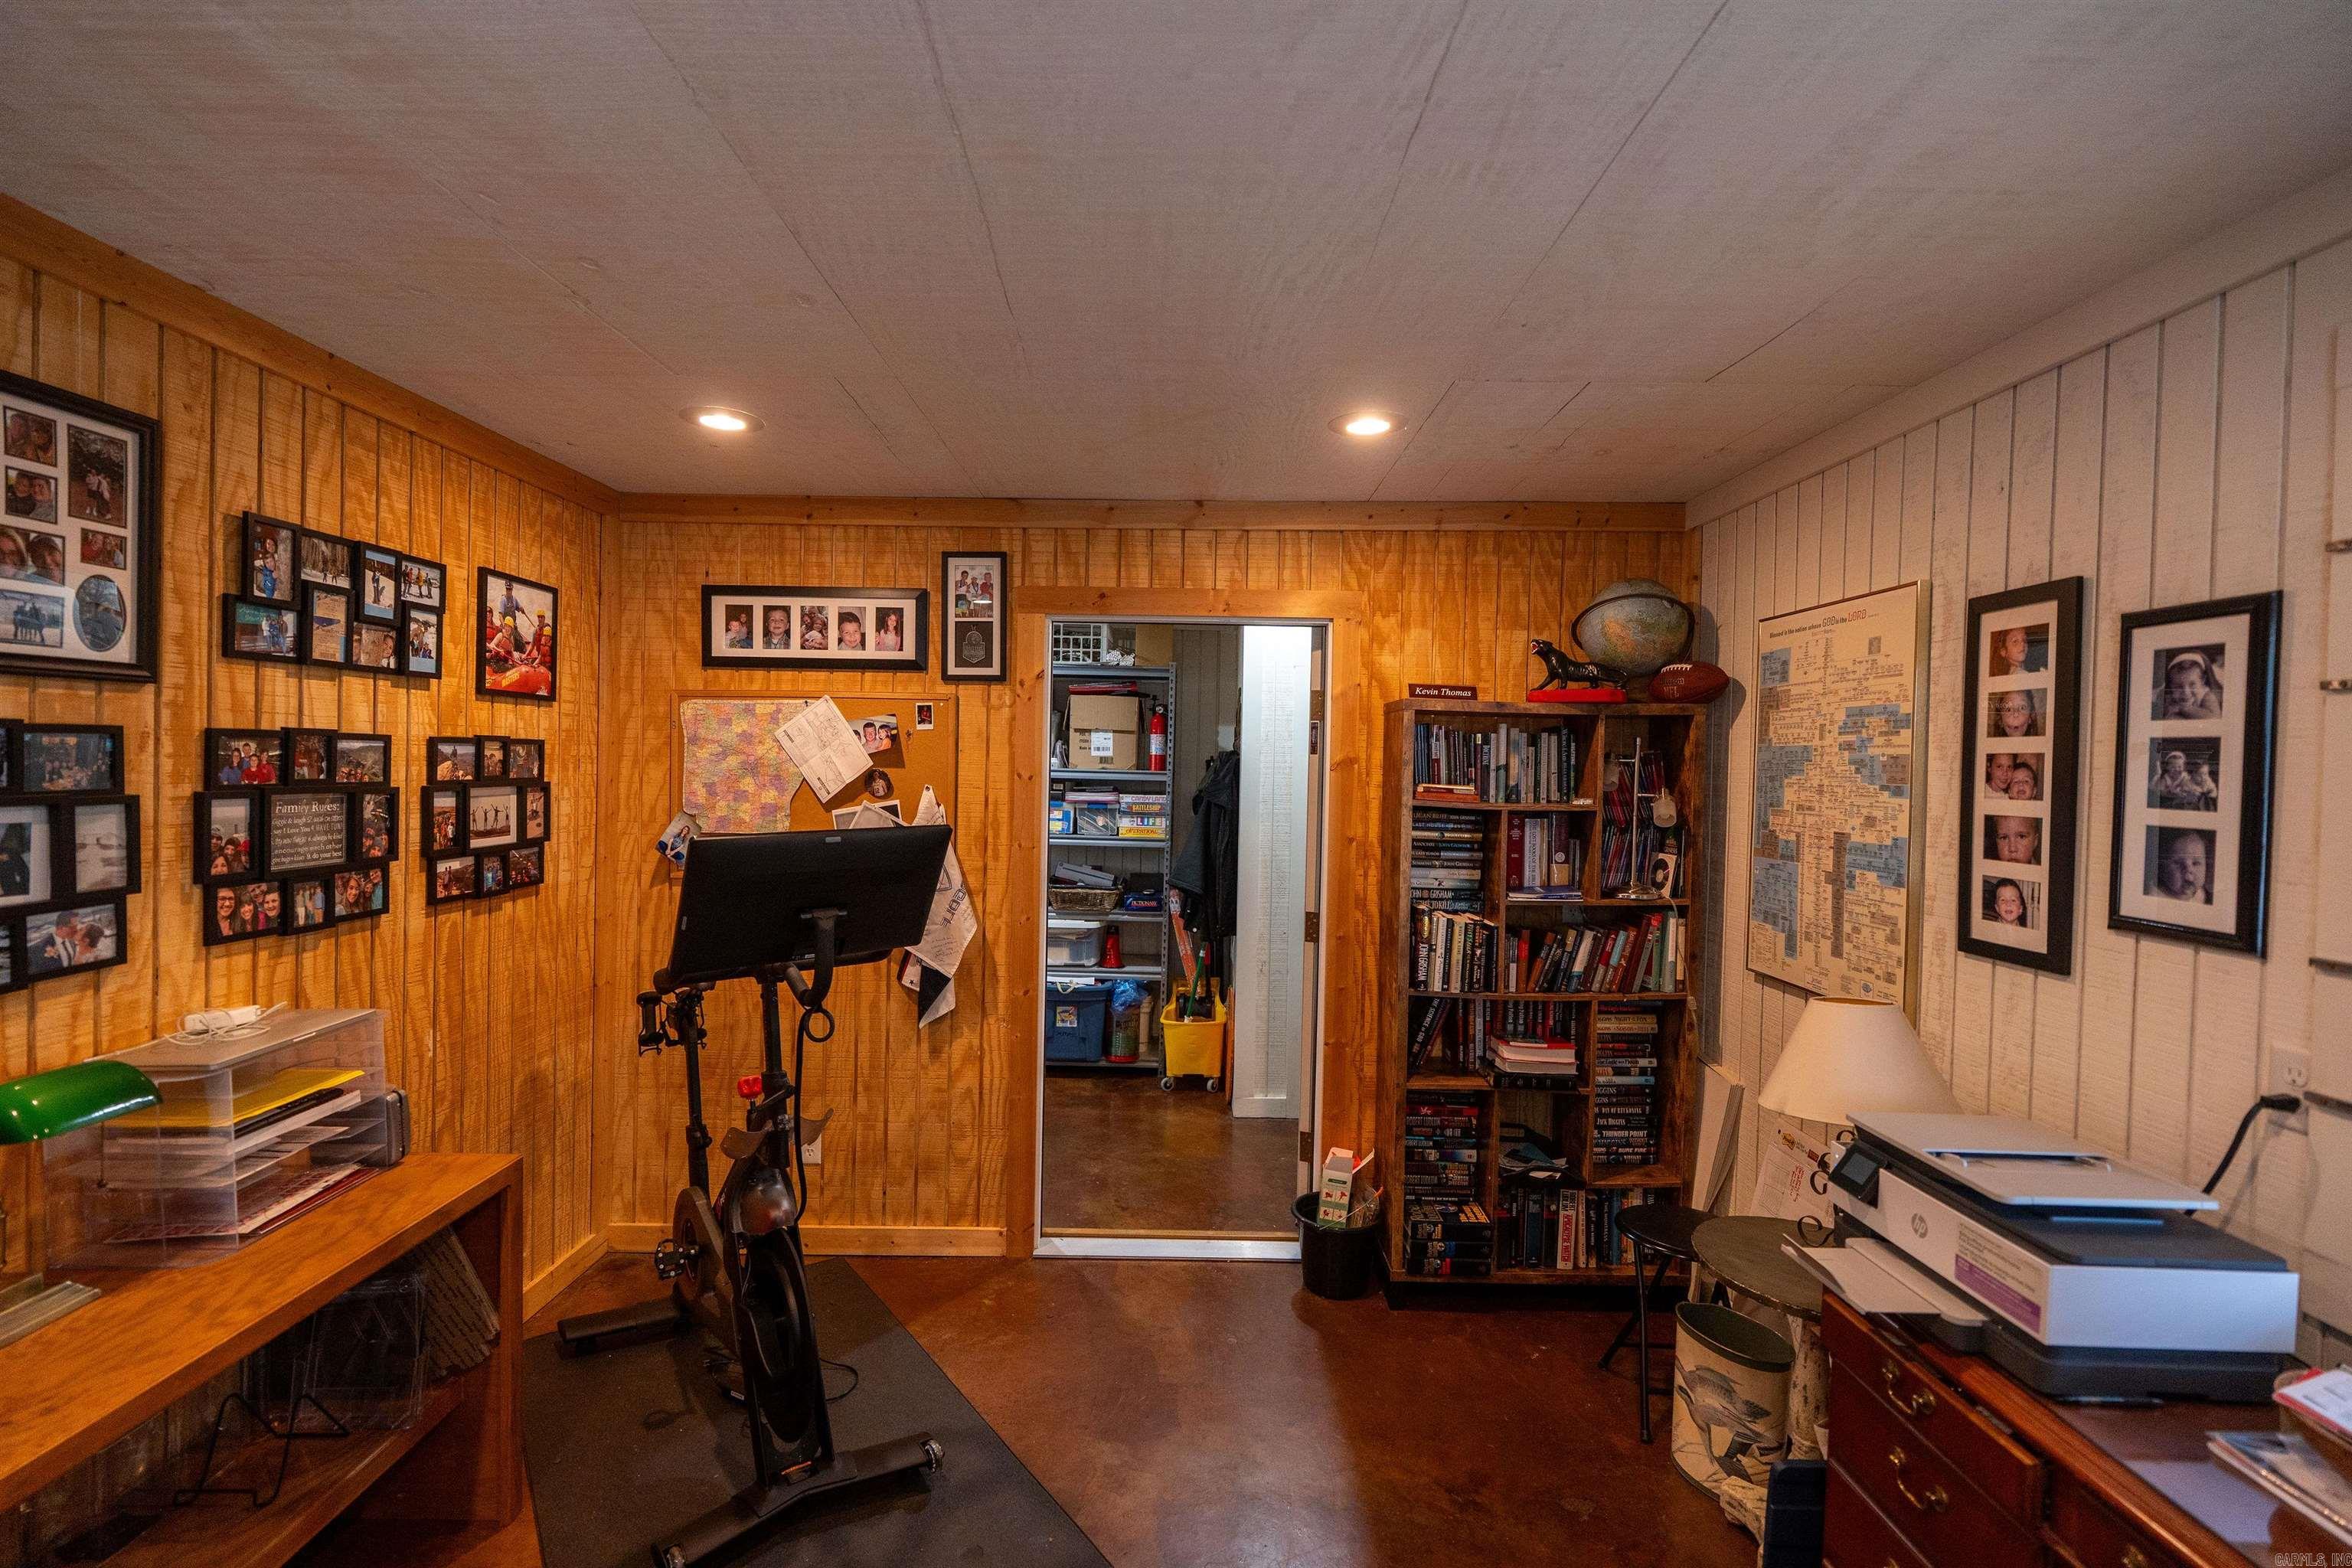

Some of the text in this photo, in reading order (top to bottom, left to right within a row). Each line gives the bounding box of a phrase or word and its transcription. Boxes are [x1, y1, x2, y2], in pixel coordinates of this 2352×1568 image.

[1769, 630, 1784, 639] Blessed
[1822, 616, 1836, 628] GOD
[1847, 609, 1867, 622] LORD
[1415, 687, 1472, 697] Kevin Thomas
[276, 798, 340, 814] Family Rules:
[1137, 817, 1162, 826] LIFE
[325, 841, 342, 850] other
[1410, 889, 1452, 899] OHN GRISHAM
[1419, 942, 1429, 958] JOHN
[1418, 958, 1429, 981] GRISHAM
[1423, 1008, 1436, 1027] SCIENCE
[1563, 1214, 1573, 1244] APOCALYPSE
[1912, 1214, 1928, 1238] hp
